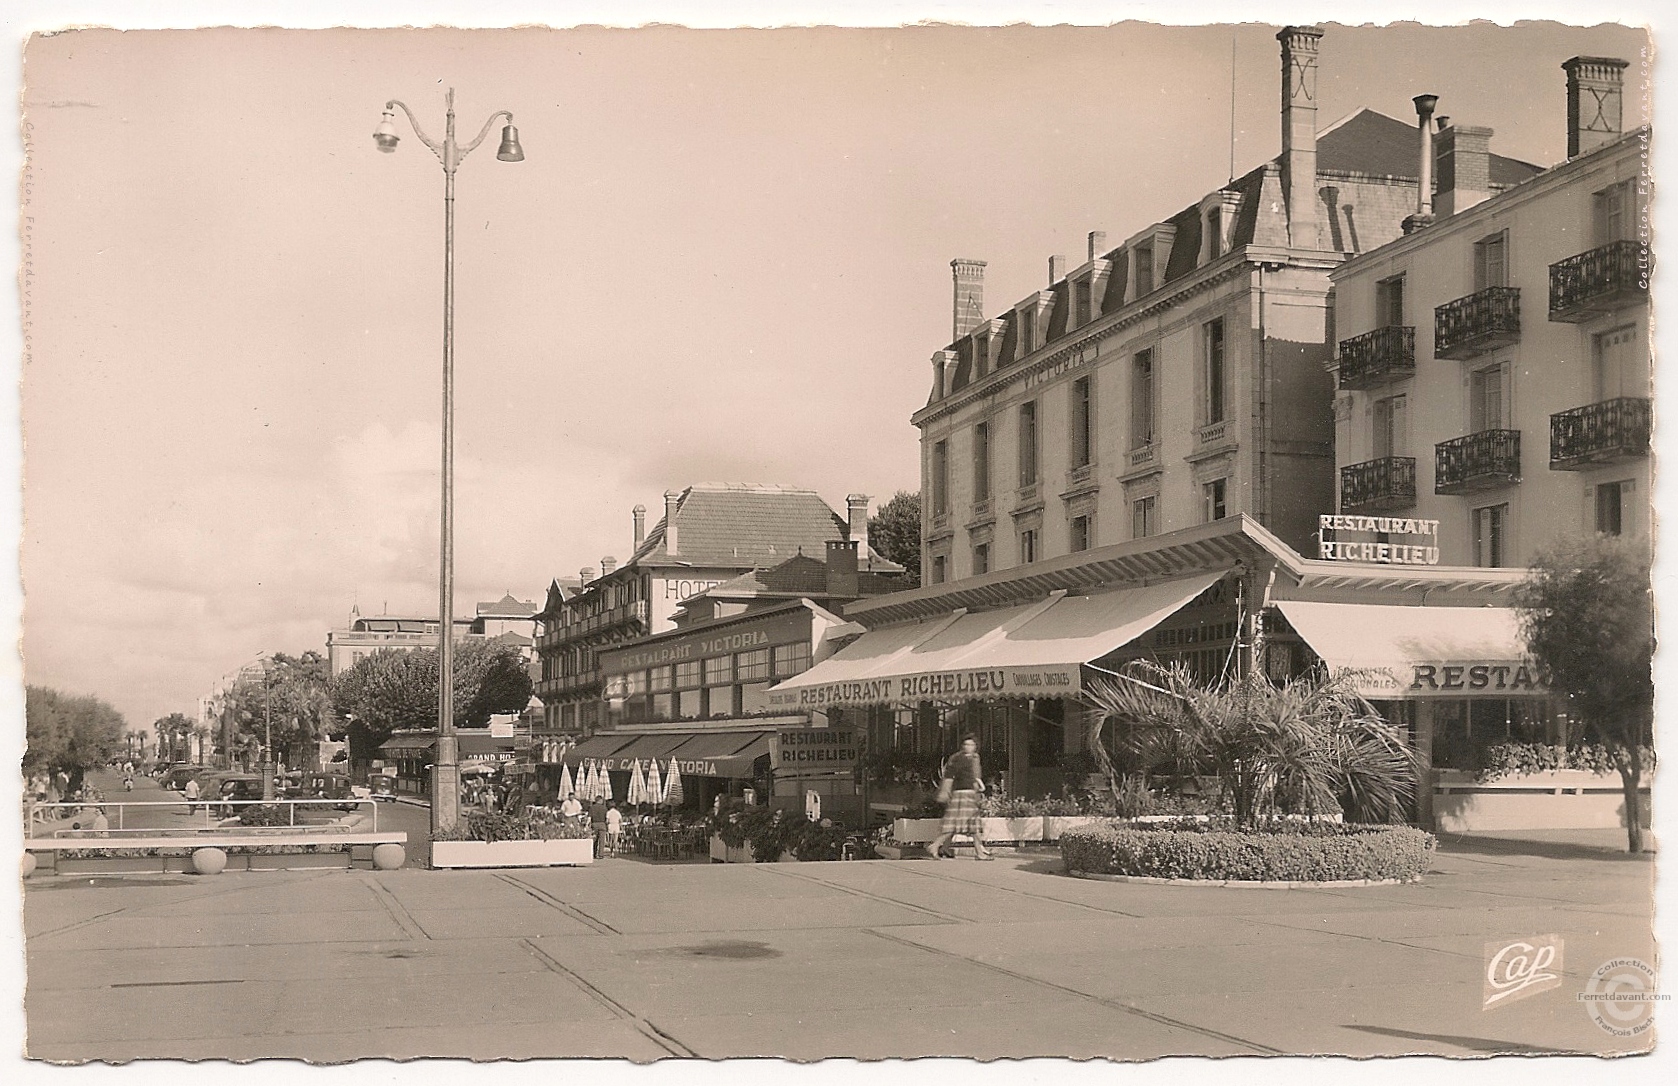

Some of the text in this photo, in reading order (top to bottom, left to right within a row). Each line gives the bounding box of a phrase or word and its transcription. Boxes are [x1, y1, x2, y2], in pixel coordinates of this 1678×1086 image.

[1024, 348, 1085, 390] VICTORIA
[1320, 514, 1440, 535] RESTAURANT
[1320, 541, 1440, 565] RICHELIEU
[701, 630, 769, 653] VICTORIA
[800, 679, 892, 705] RESTAURANT
[900, 670, 1005, 697] RICHELIEU
[781, 731, 853, 745] RESTAURANT
[499, 753, 516, 762] HO
[782, 748, 856, 762] RICHELIEU
[659, 759, 717, 775] VITORIA
